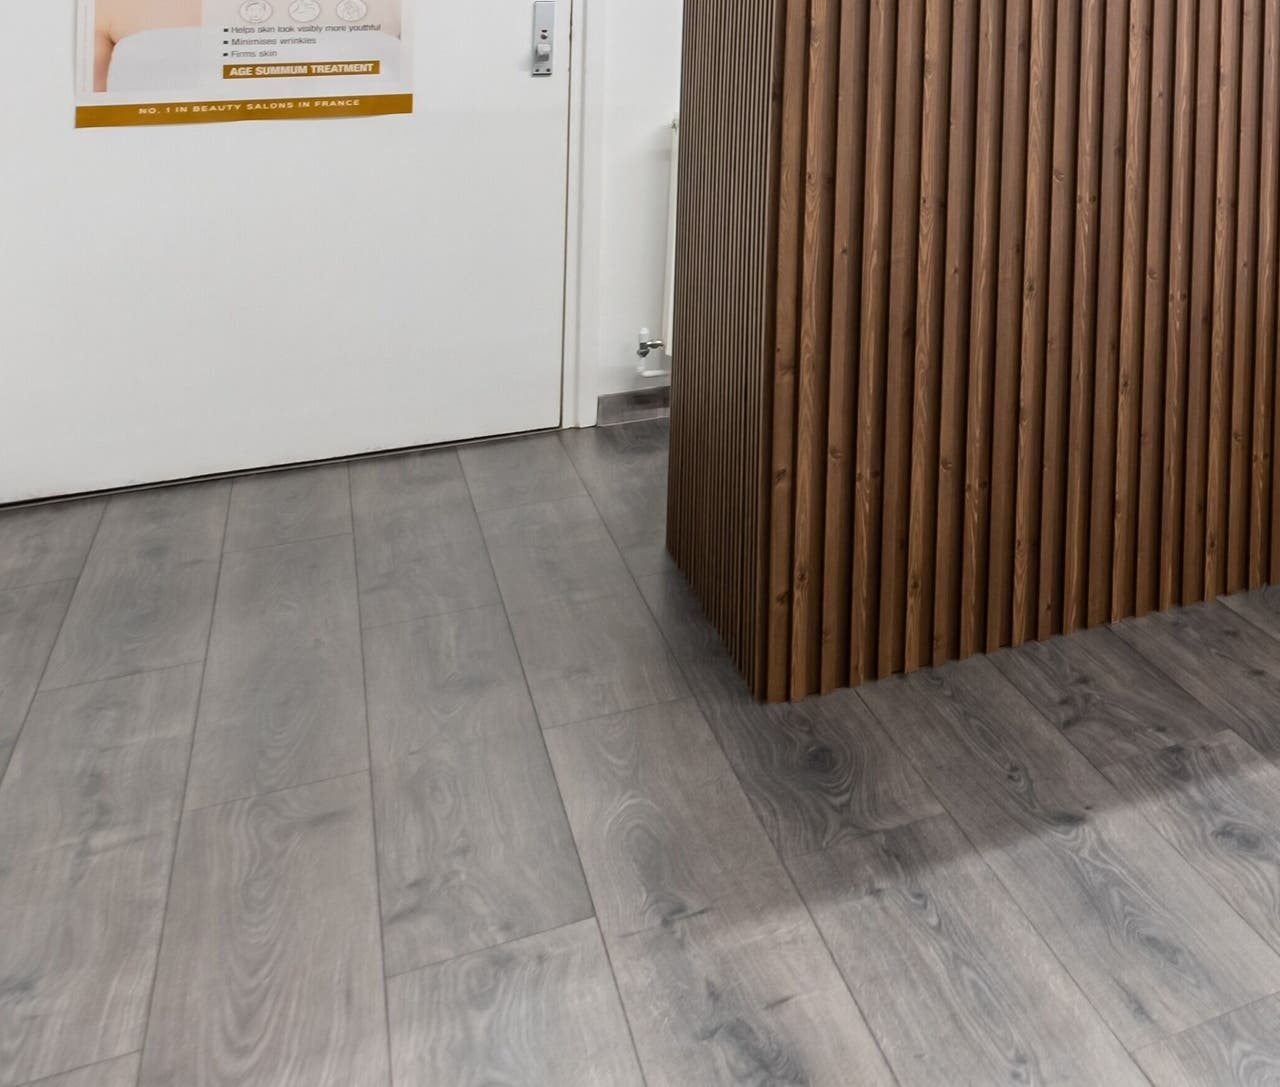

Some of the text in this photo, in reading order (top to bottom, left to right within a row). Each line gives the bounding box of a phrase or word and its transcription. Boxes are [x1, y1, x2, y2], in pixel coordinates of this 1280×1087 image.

[231, 26, 255, 34] Helps
[277, 25, 295, 33] look
[297, 25, 322, 34] visibly
[349, 24, 382, 33] youthful
[231, 37, 317, 46] Minimises wrinkles
[231, 49, 278, 58] Firms skin
[229, 63, 374, 76] AGE SUMMUM TREATMENT
[192, 104, 241, 113] BEAUTY
[246, 102, 295, 111] SALONS
[314, 99, 361, 108] FRANCE
